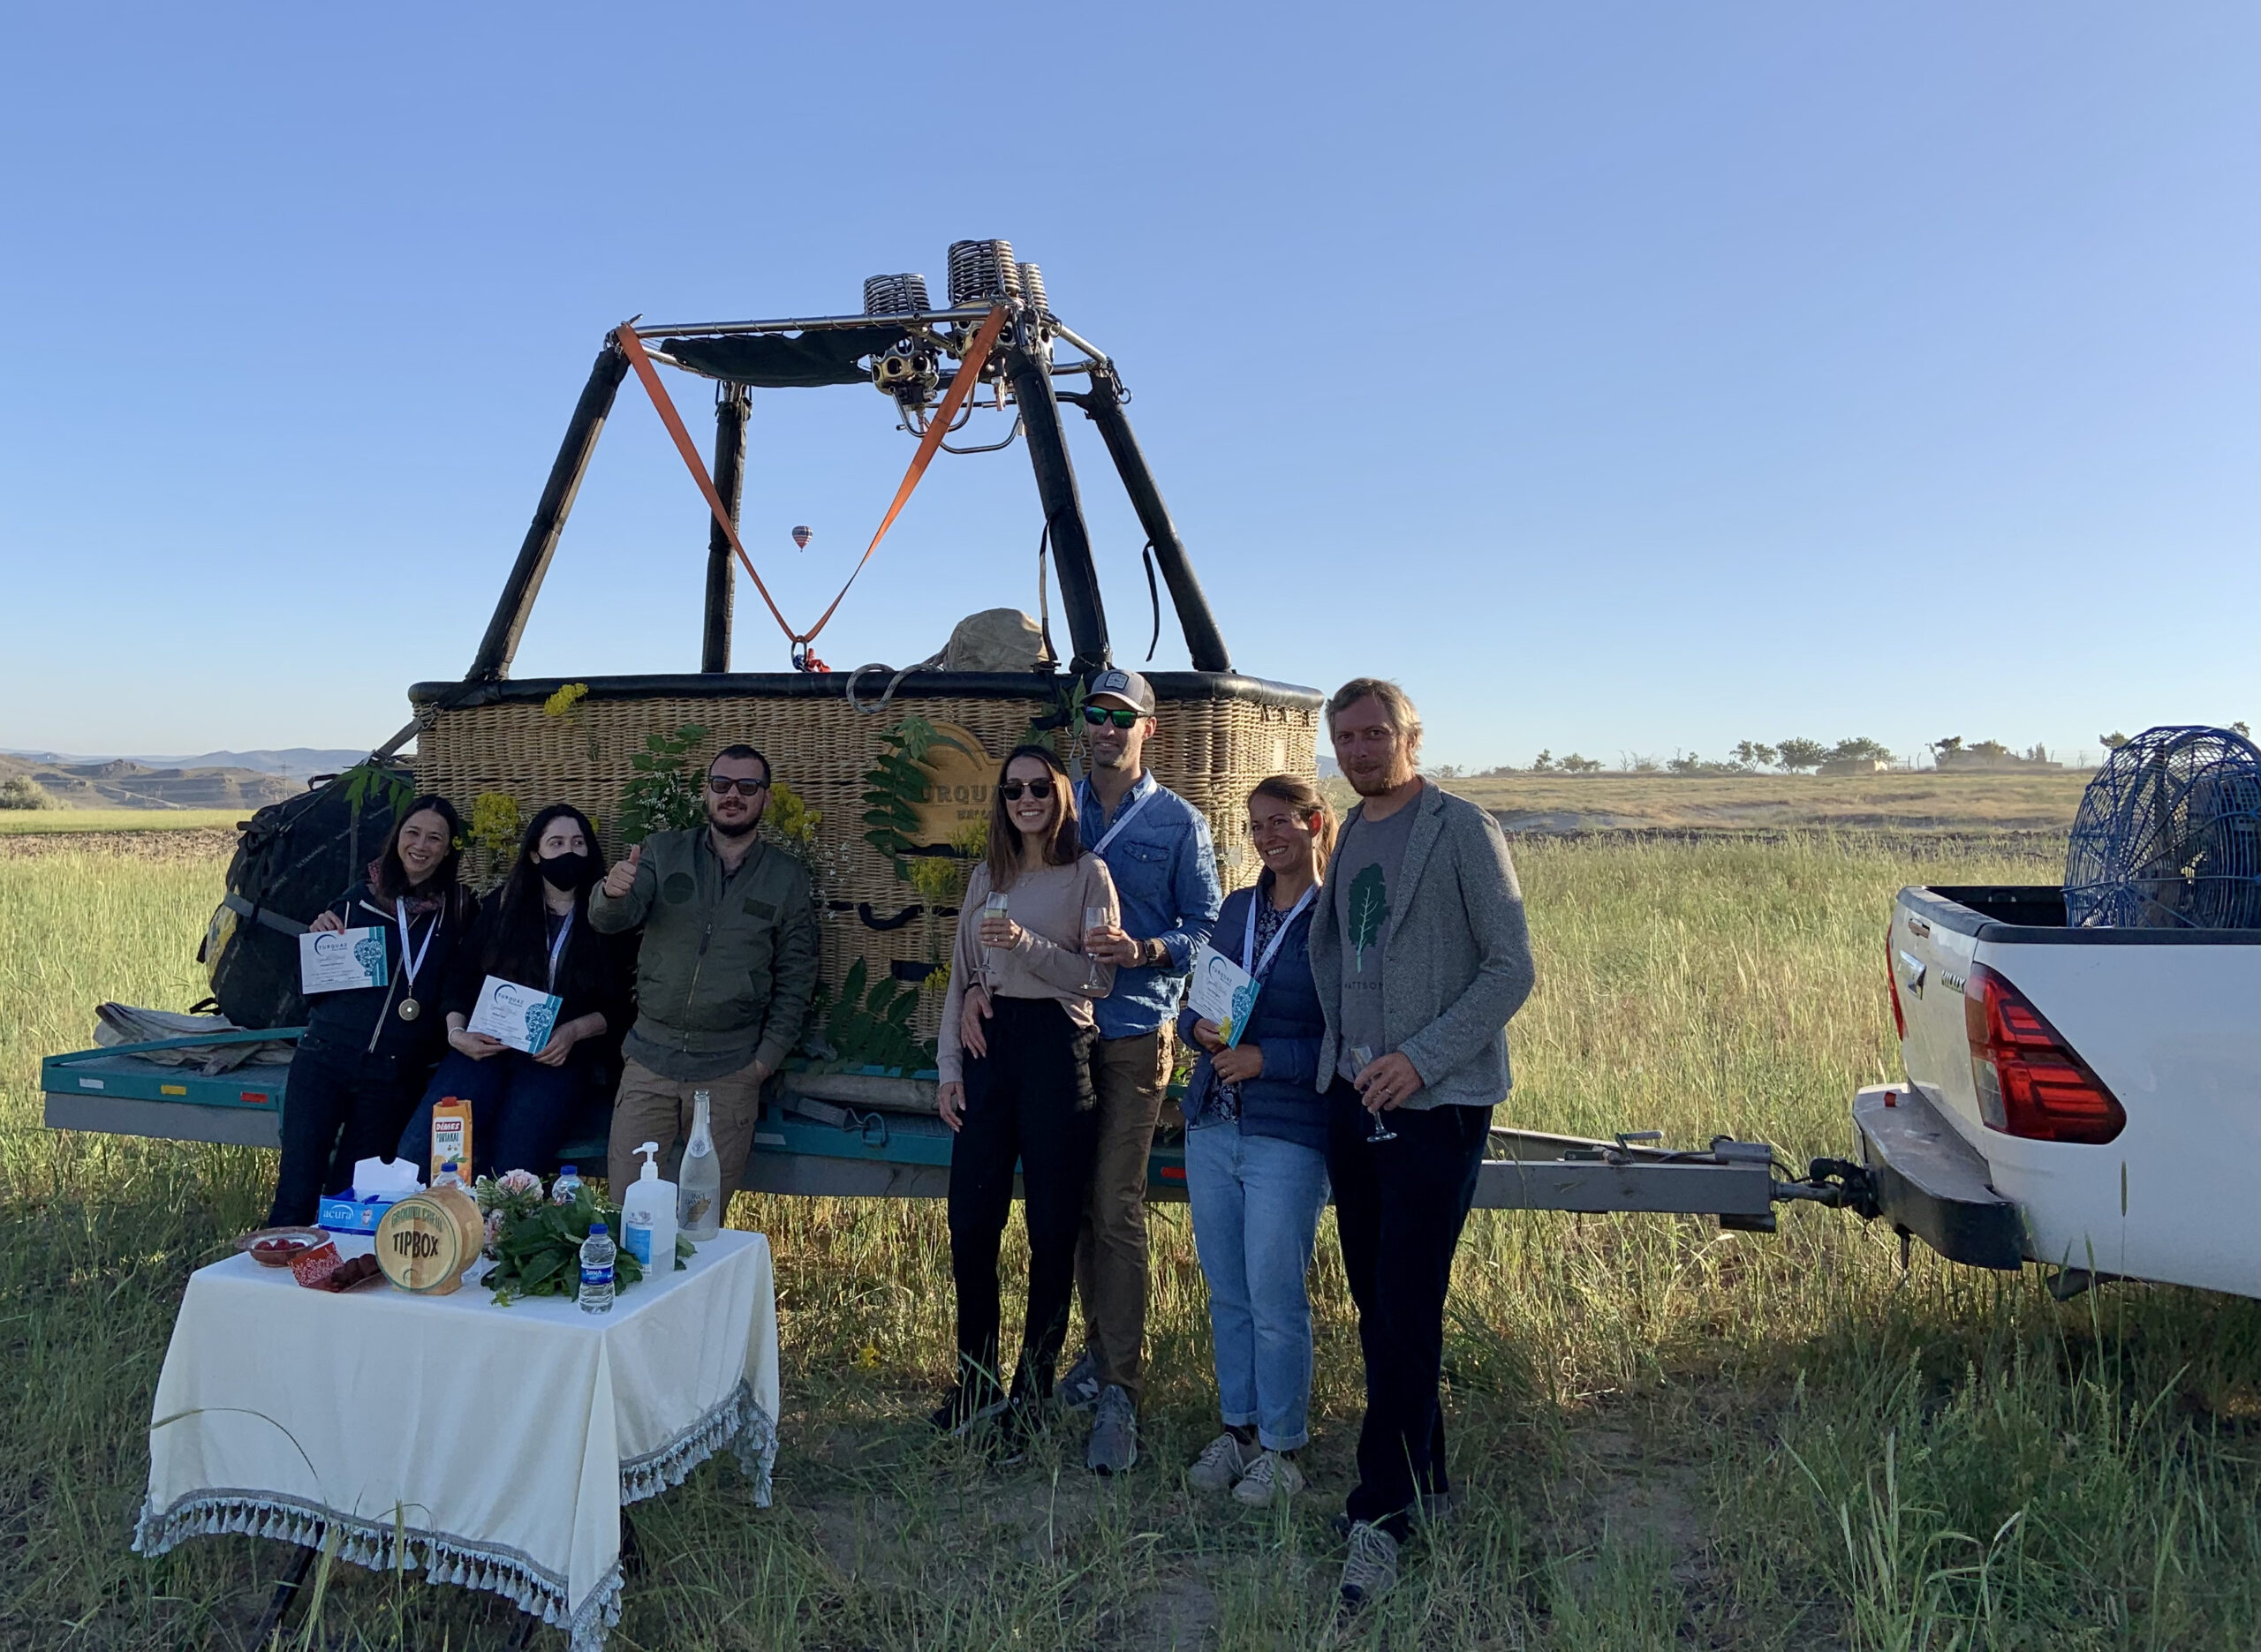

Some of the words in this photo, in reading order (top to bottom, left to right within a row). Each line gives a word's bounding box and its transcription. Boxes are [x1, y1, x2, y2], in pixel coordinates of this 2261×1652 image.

[921, 783, 996, 804] URQU
[322, 1209, 352, 1220] acura
[392, 1230, 439, 1258] TIPBOX
